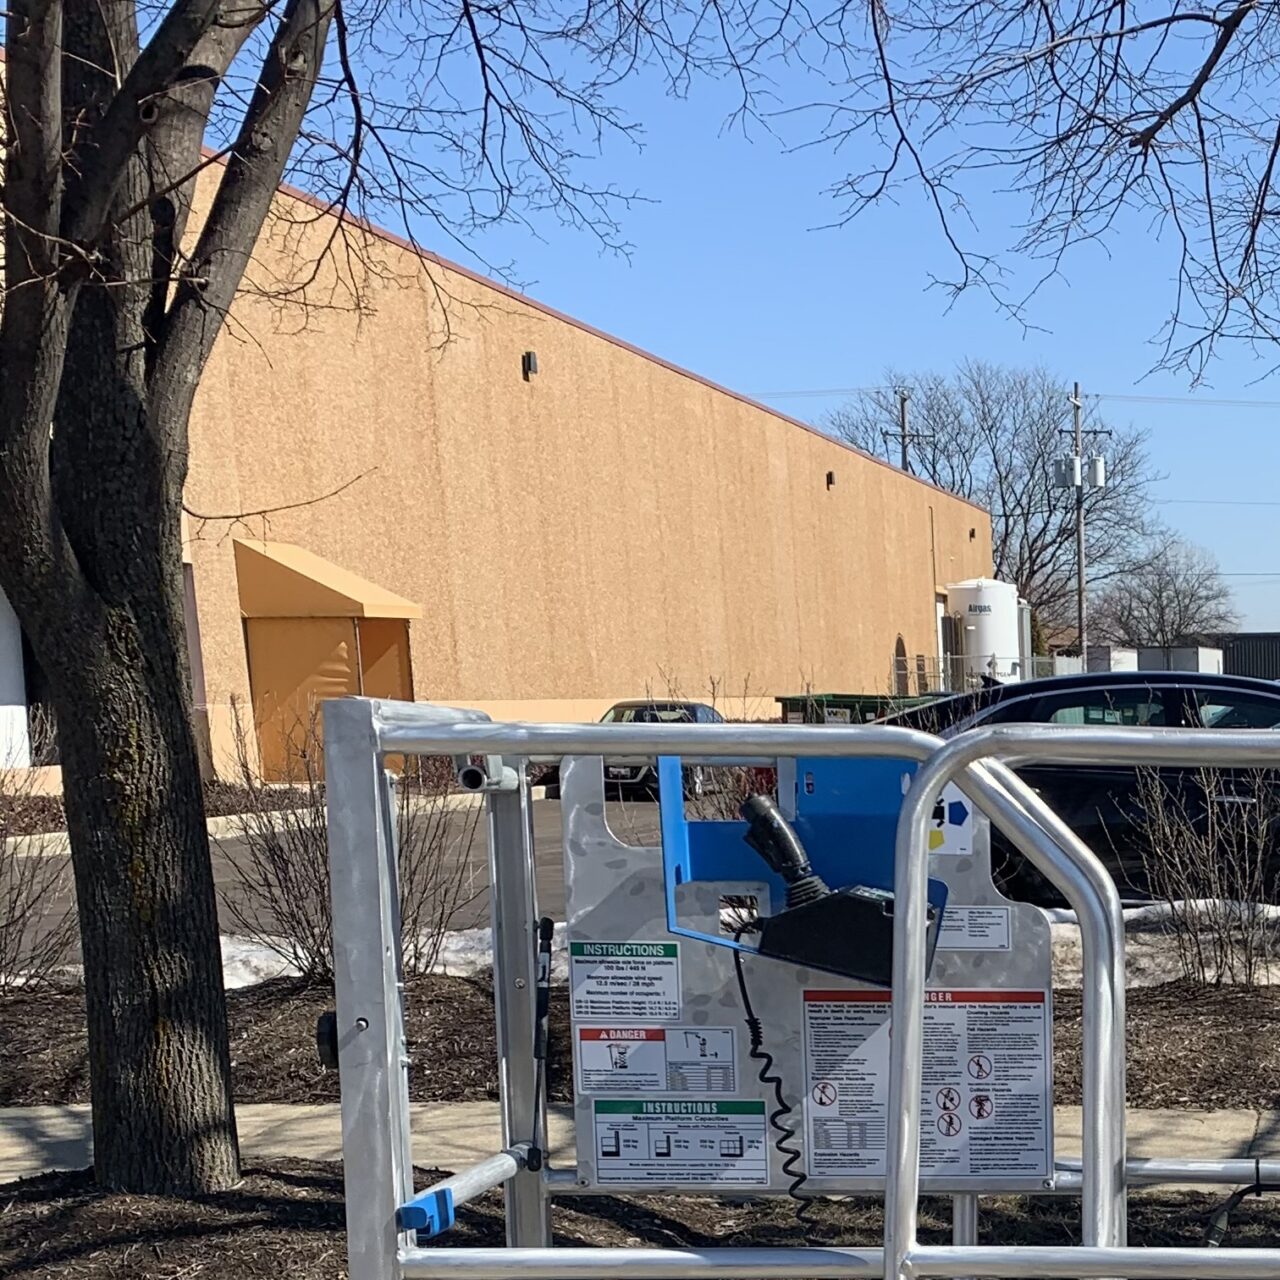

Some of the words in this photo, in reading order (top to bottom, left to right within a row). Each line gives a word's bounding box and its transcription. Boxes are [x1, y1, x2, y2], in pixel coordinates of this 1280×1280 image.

[968, 604, 992, 613] Airgas
[583, 944, 665, 956] INSTRUCTIONS
[610, 1030, 646, 1040] DANGER
[643, 1102, 718, 1113] INSTRUCTIONS
